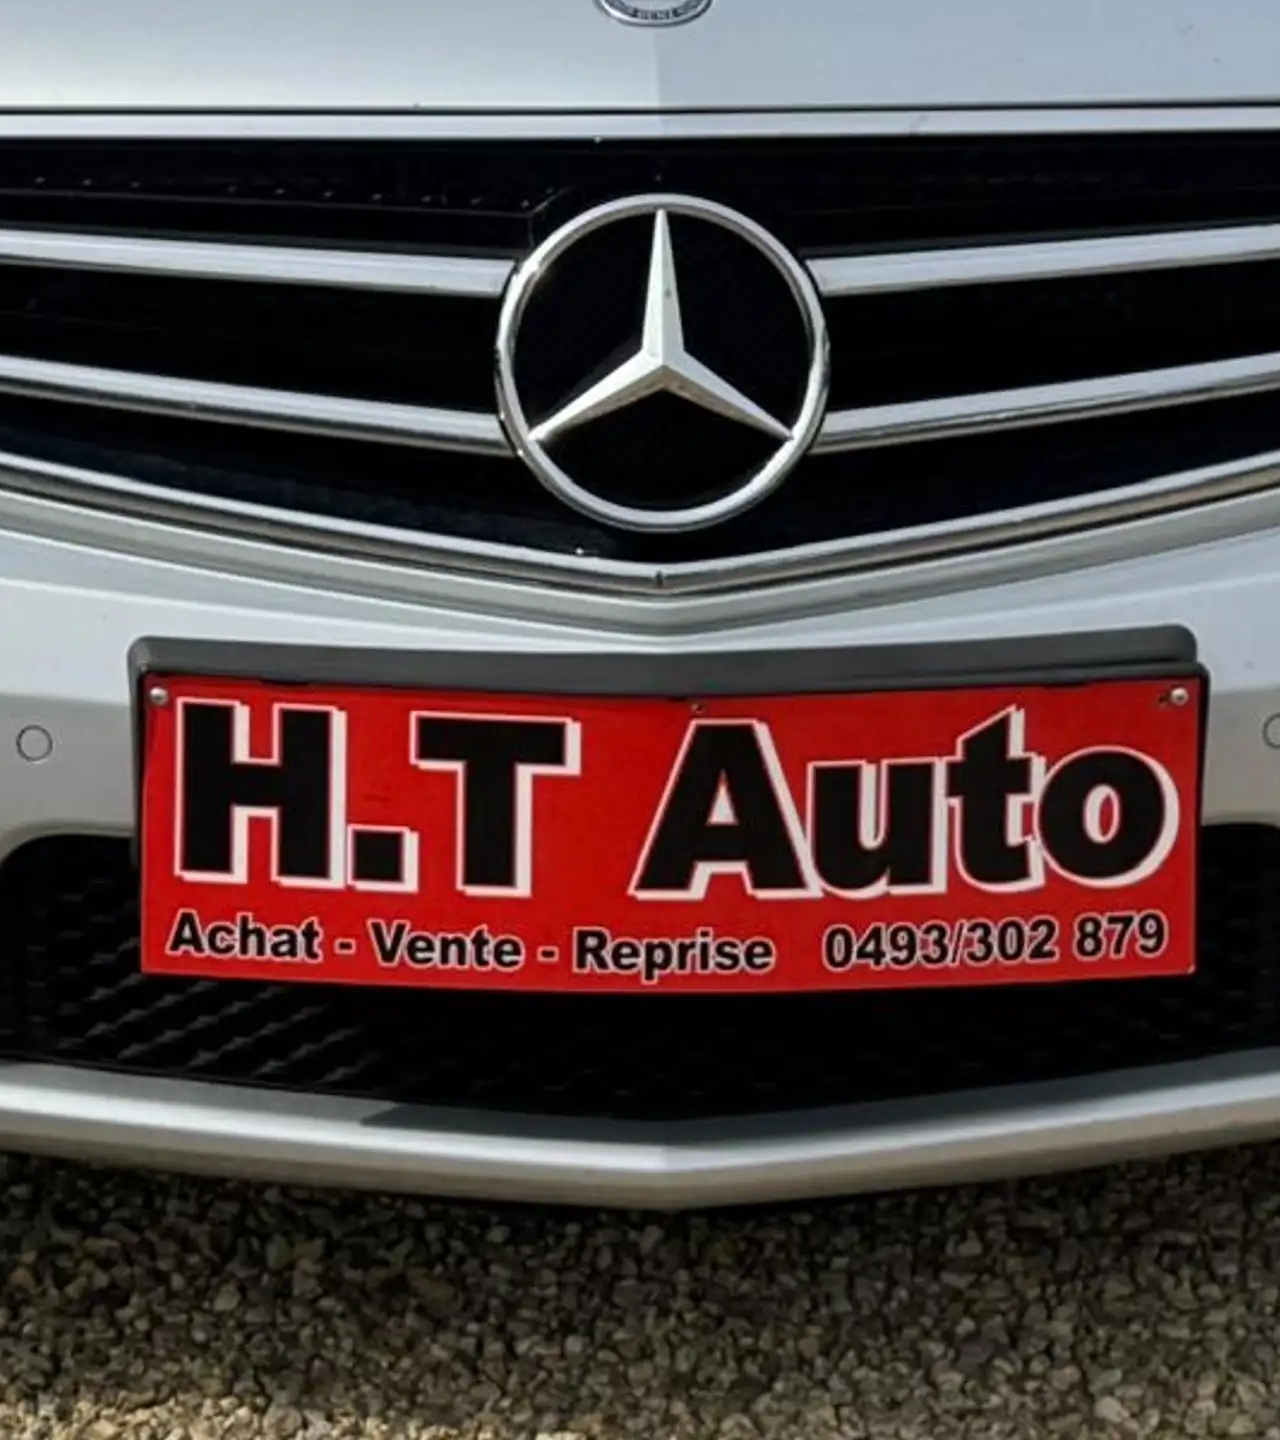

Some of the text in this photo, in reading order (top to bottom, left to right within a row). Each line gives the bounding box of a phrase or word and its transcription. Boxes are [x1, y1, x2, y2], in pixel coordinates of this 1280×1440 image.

[174, 697, 1180, 900] H.T Auto
[166, 908, 323, 962] Achat
[367, 919, 526, 971] Vente
[572, 927, 775, 985] Reprise
[823, 918, 1059, 971] 0493/302
[1073, 910, 1168, 960] 879
